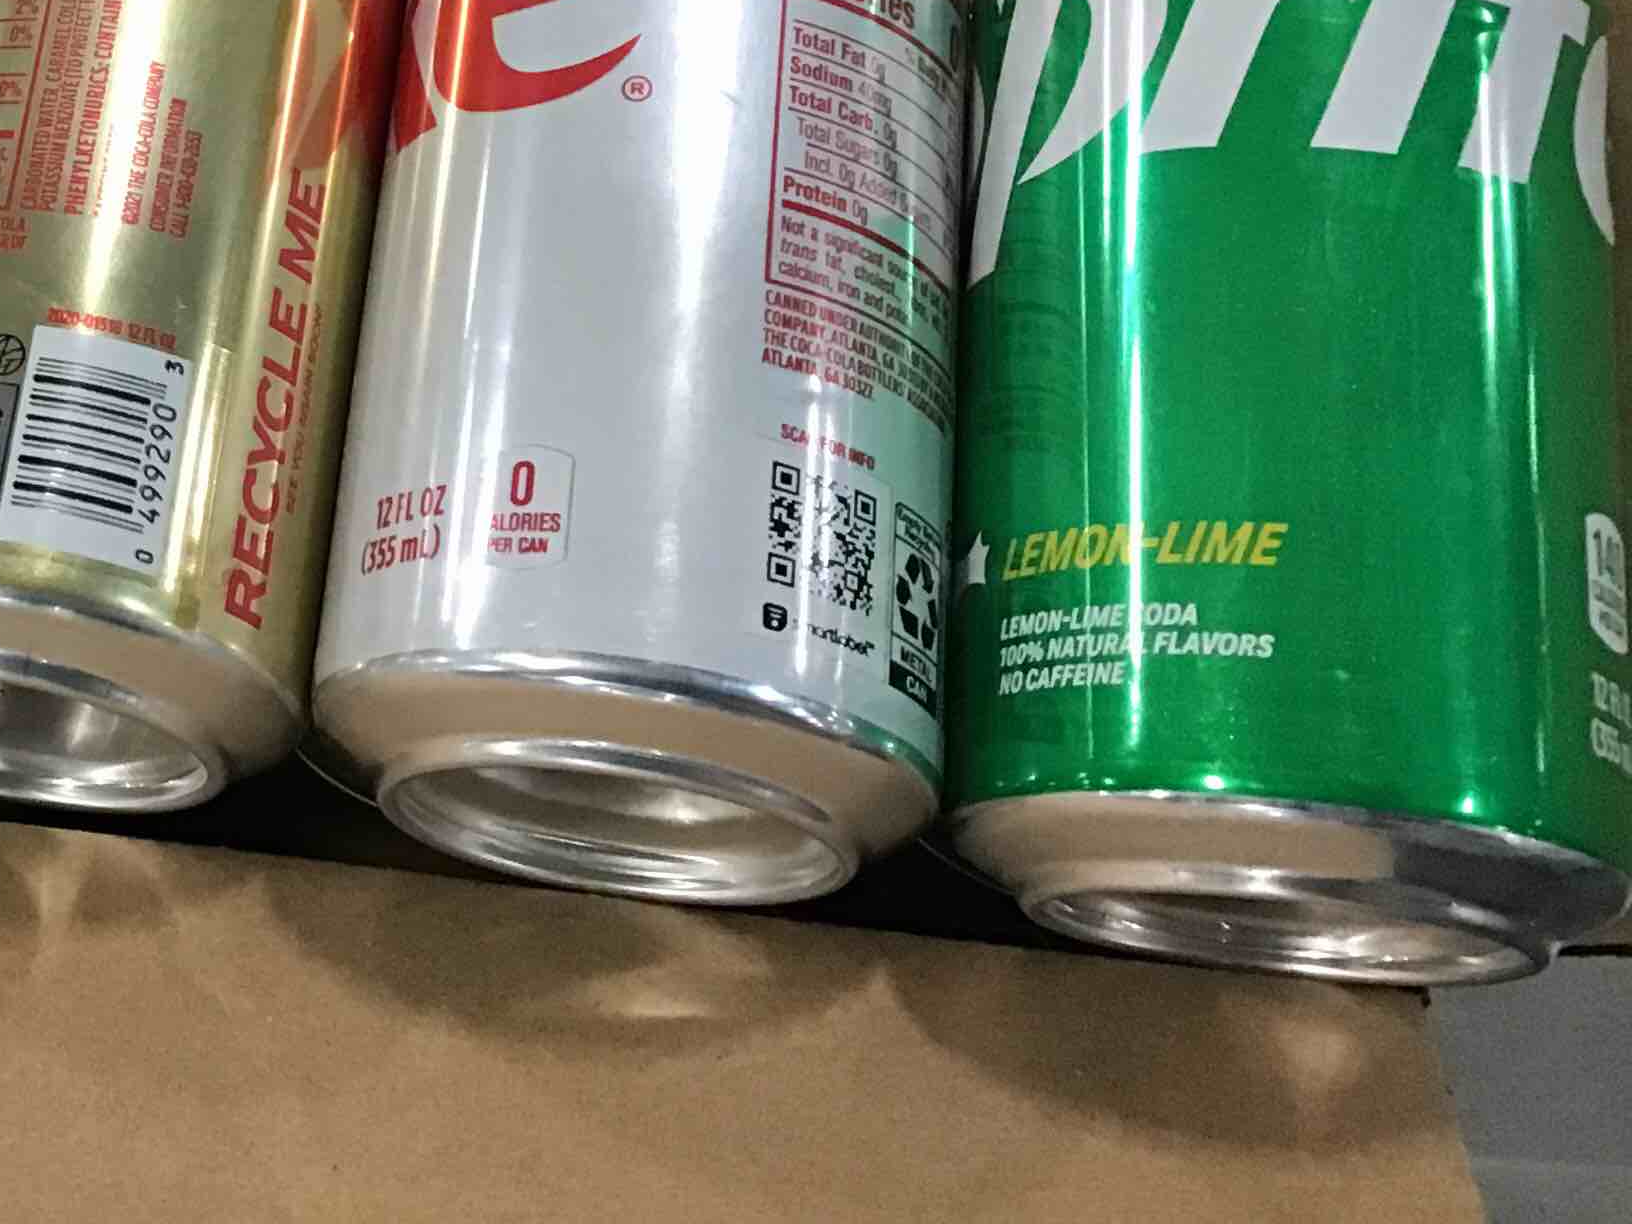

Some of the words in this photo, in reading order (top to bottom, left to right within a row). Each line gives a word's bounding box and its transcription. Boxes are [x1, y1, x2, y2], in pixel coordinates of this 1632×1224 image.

[792, 25, 836, 58] Total
[841, 42, 866, 70] Fat
[789, 54, 854, 94] Sodium
[789, 83, 833, 116] Total
[837, 100, 880, 135] Carb.
[796, 116, 832, 145] Total
[803, 148, 835, 175] Incl.
[783, 175, 848, 212] Protein
[850, 198, 868, 226] 0g
[781, 214, 806, 242] Not
[765, 289, 817, 317] CANNED
[761, 327, 790, 349] THE
[225, 287, 310, 629] RECYCLE
[272, 166, 333, 285] ME
[847, 447, 876, 471] INFO
[509, 459, 536, 507] 0
[376, 496, 393, 531] 12
[396, 491, 414, 526] FL
[419, 484, 448, 519] OZ
[489, 511, 562, 534] ALORIES
[360, 532, 397, 577] (355
[400, 523, 442, 565] mL)
[517, 536, 550, 554] CAN
[1001, 520, 1288, 582] LEMON-LIME
[1000, 603, 1124, 641] LEMON-LIME
[1000, 637, 1045, 669] 100%
[1046, 631, 1148, 659] NATURAL
[1153, 630, 1276, 660] FLAVORS
[998, 668, 1024, 696] NO
[1025, 660, 1126, 692] CAFFEINE
